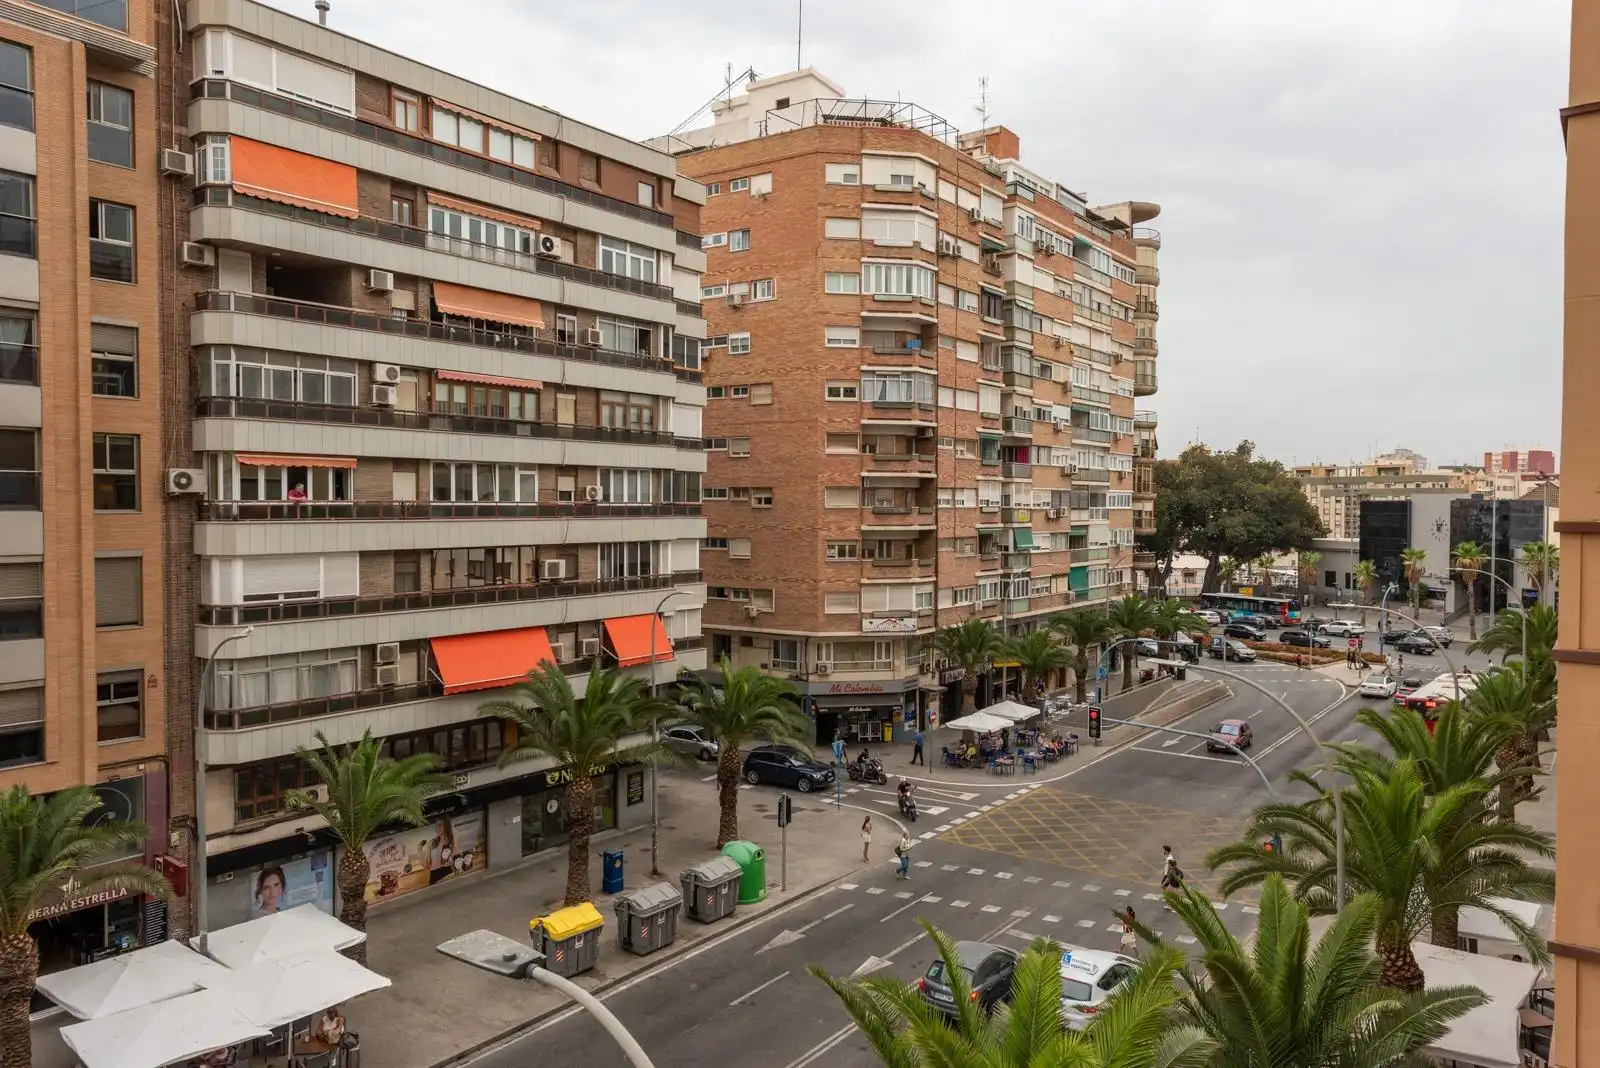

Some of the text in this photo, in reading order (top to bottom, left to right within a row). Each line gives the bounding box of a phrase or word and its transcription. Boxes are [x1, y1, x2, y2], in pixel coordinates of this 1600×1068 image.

[829, 682, 883, 693] Mi Colombia
[71, 887, 127, 909] ESTRELLA
